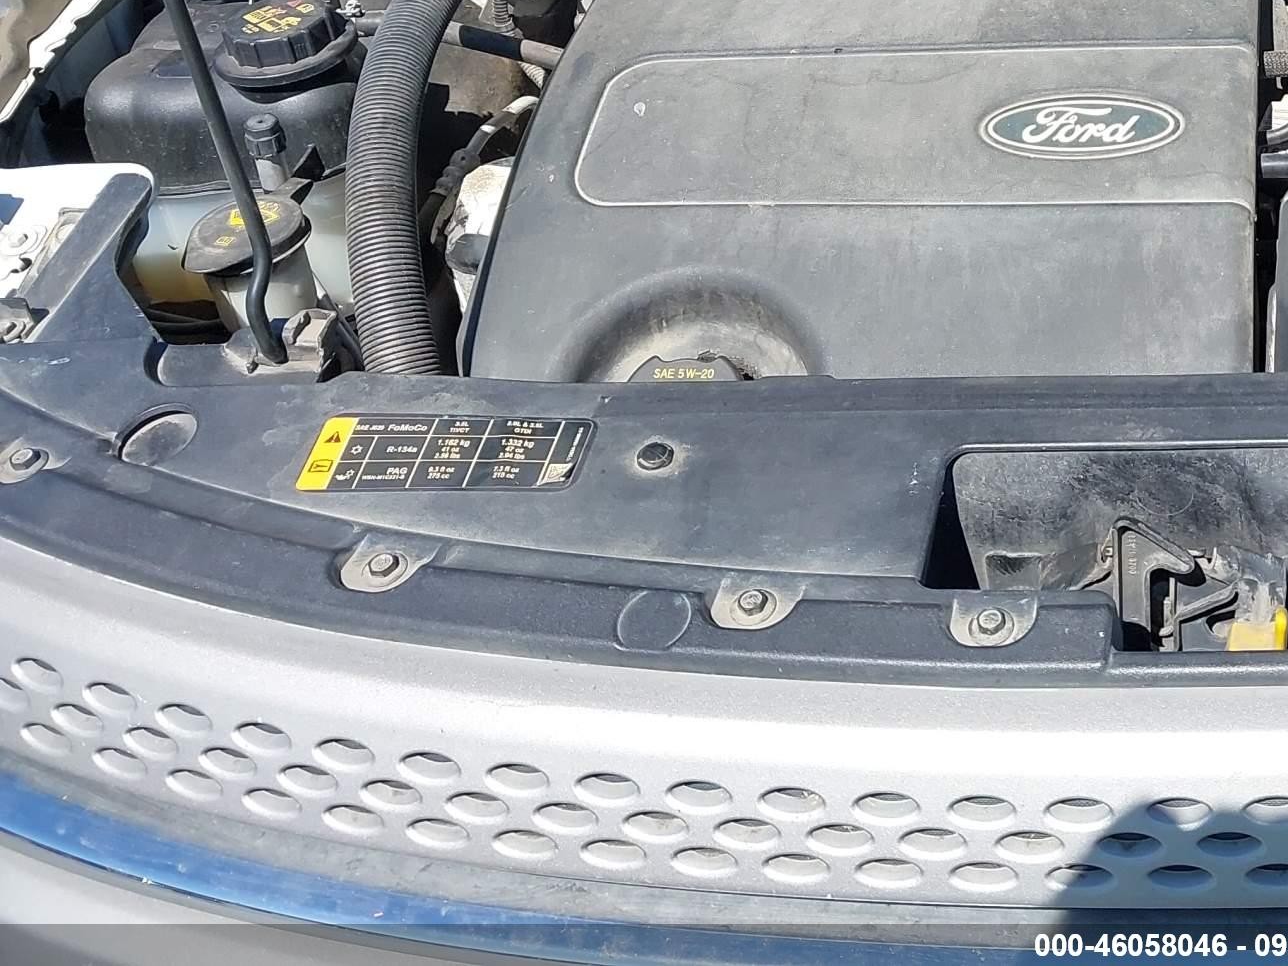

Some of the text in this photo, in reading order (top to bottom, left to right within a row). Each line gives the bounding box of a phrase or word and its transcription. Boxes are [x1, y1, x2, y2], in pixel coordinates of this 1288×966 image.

[1022, 107, 1140, 143] Ford
[653, 368, 715, 379] SAE 5W-20
[387, 423, 428, 432] FoMoCo
[459, 439, 471, 448] kg
[523, 440, 535, 449] kg
[386, 445, 418, 453] R-134a
[386, 467, 408, 475] PAG
